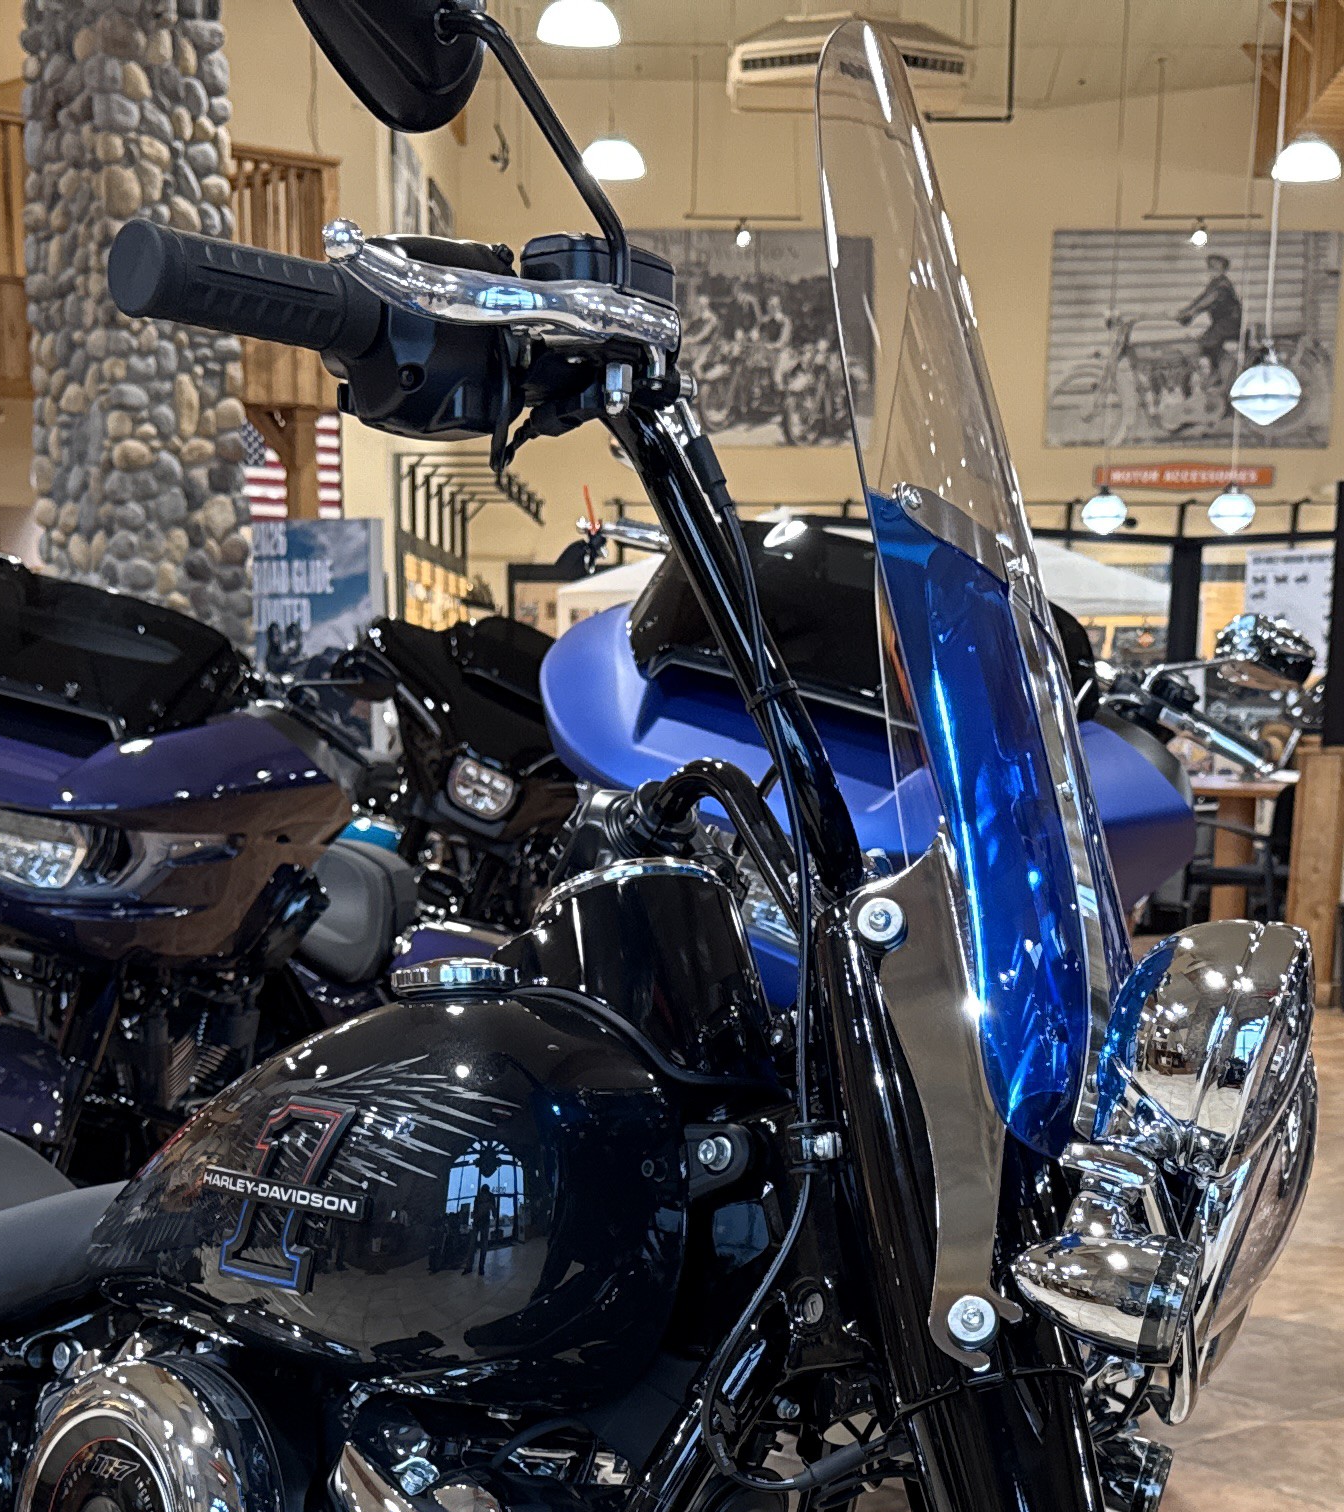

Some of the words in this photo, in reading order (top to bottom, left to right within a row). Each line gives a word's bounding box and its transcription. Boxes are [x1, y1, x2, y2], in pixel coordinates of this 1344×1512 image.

[291, 559, 335, 595] GLIDE
[202, 1170, 357, 1214] HARLEY-DAVIDSON
[90, 1452, 140, 1481] 117
